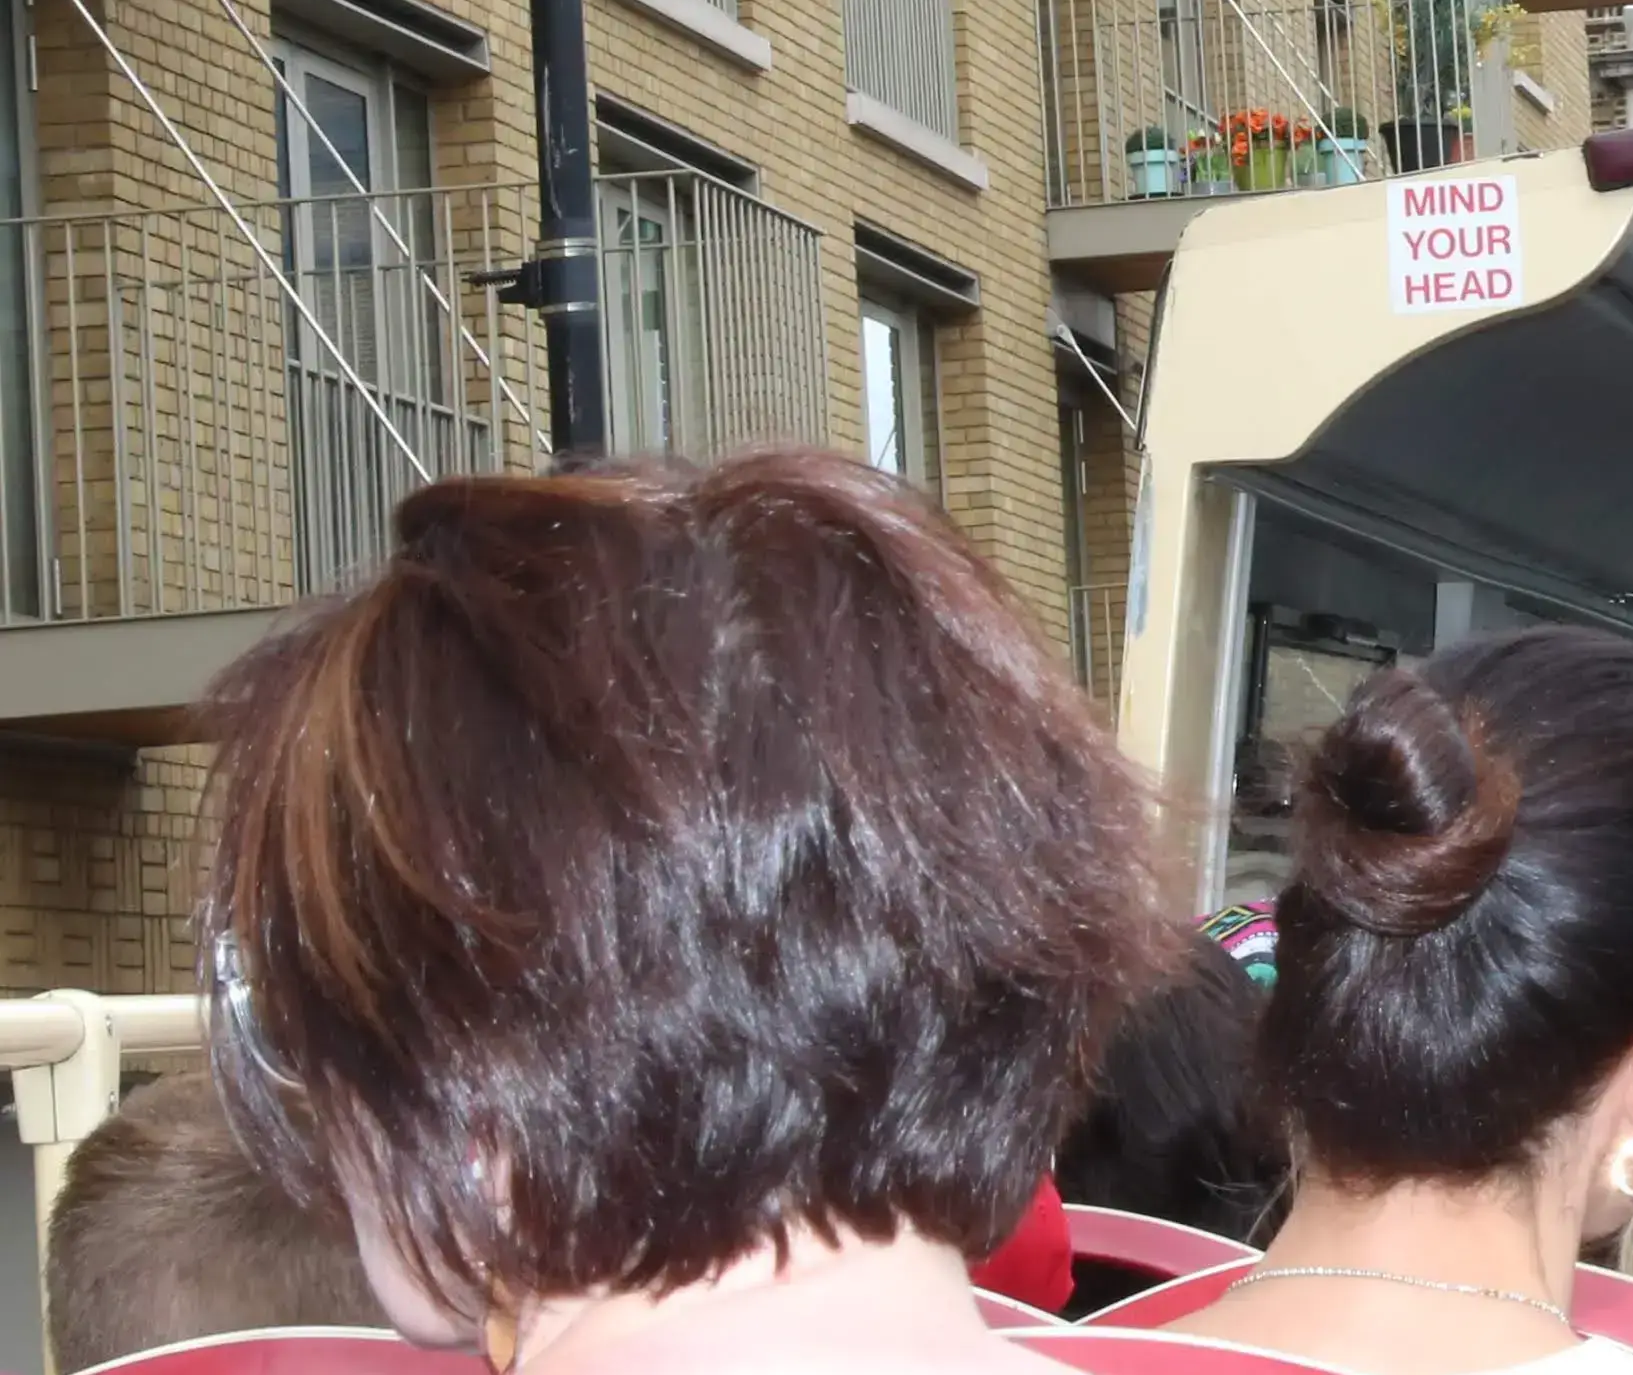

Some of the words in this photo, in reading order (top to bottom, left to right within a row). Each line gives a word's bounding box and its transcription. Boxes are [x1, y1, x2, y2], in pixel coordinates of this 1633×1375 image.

[1403, 182, 1504, 217] MIND
[1403, 224, 1511, 260] YOUR
[1404, 269, 1513, 305] HEAD
